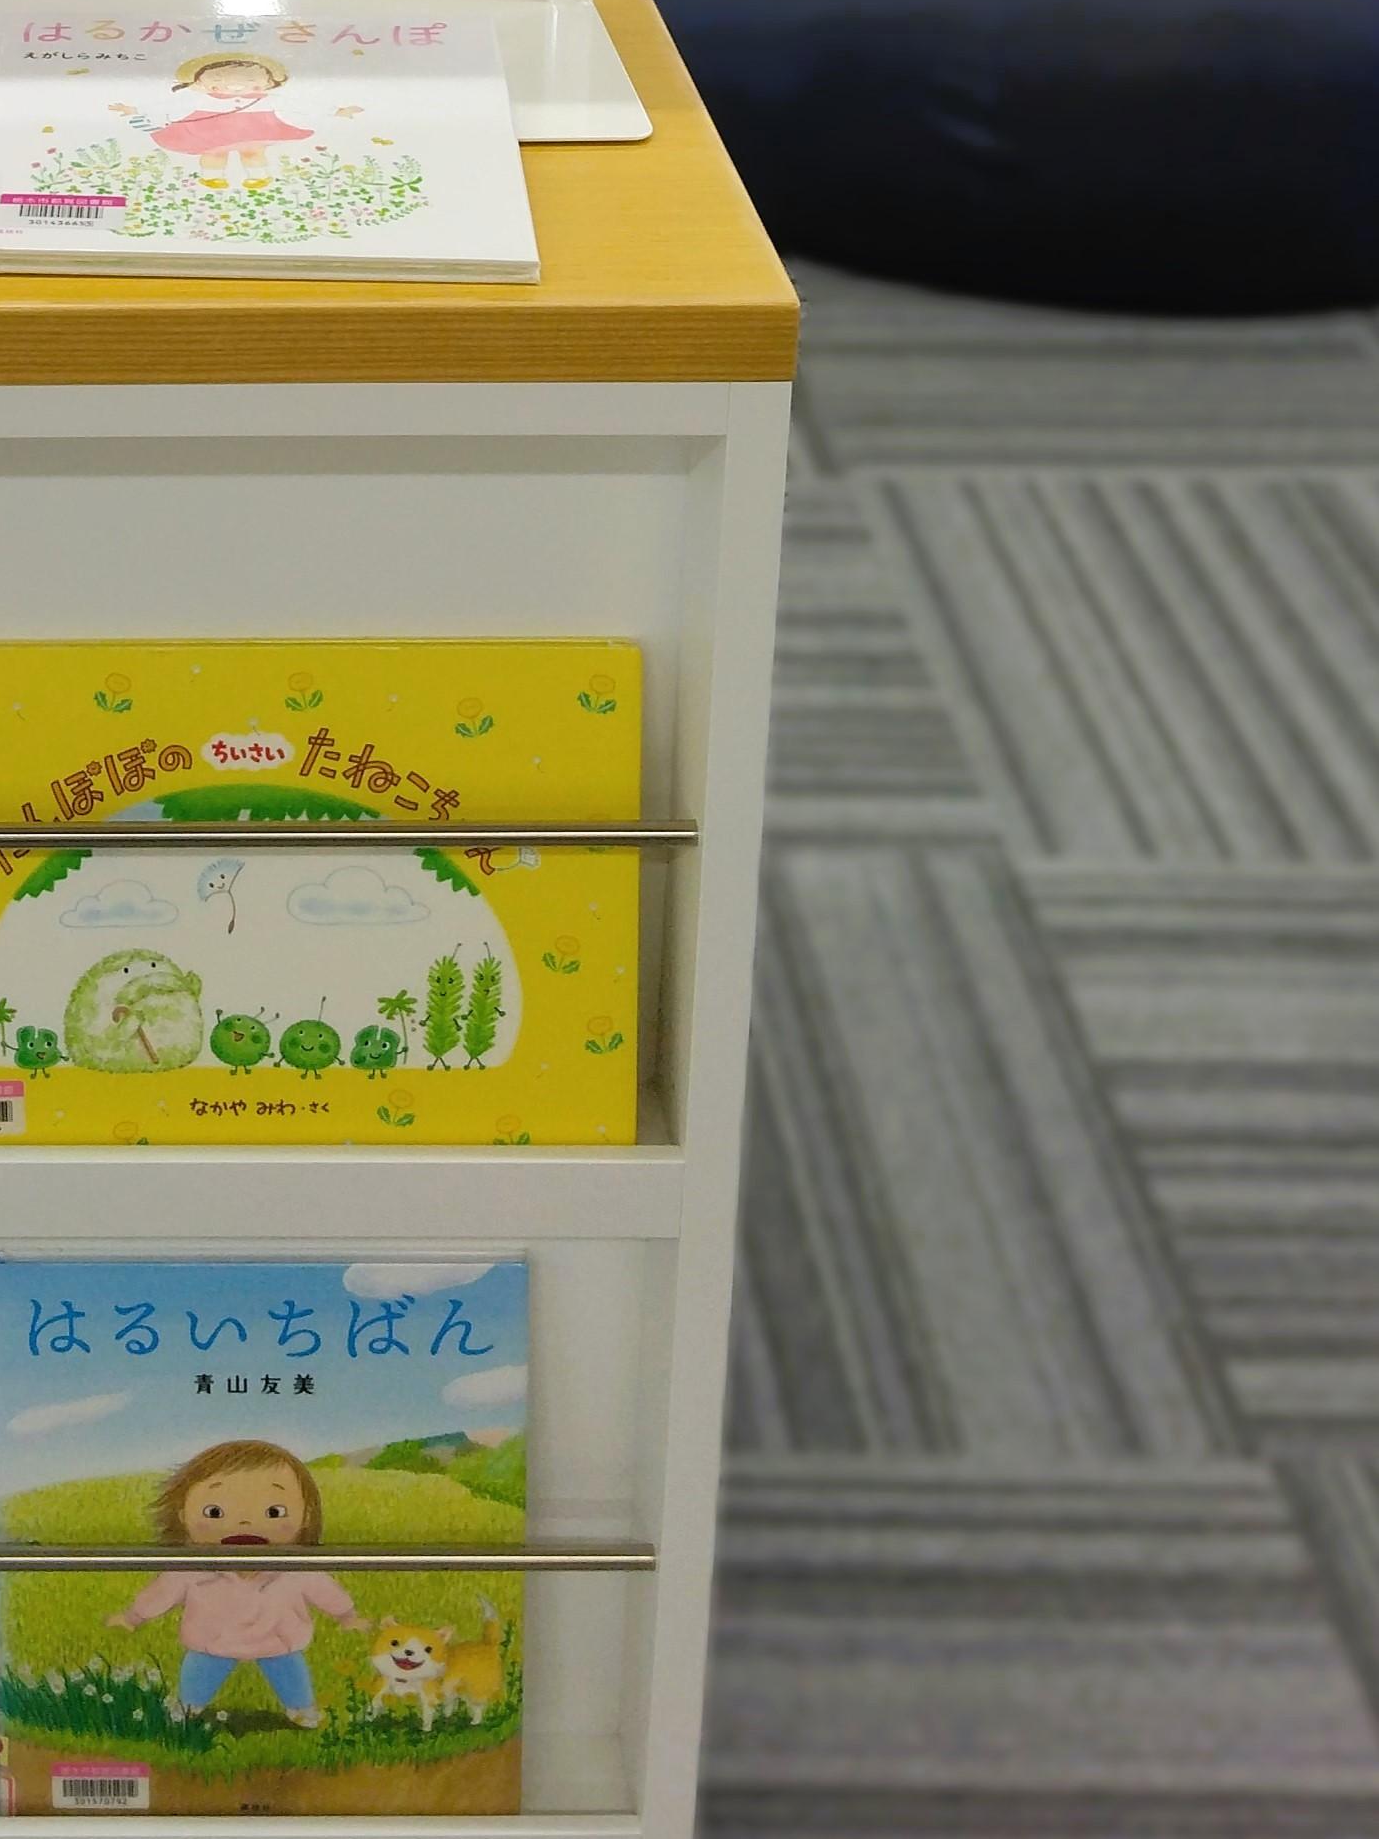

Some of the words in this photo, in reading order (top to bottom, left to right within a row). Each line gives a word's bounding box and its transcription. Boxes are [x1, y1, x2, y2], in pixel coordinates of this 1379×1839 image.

[23, 20, 449, 48] はるかぜさんぽ
[23, 52, 148, 61] えがしらみちこ
[211, 739, 285, 763] ちいさい
[189, 1098, 247, 1116] なかや
[27, 1294, 494, 1358] はるいちばん
[194, 1373, 317, 1396] 青山友美
